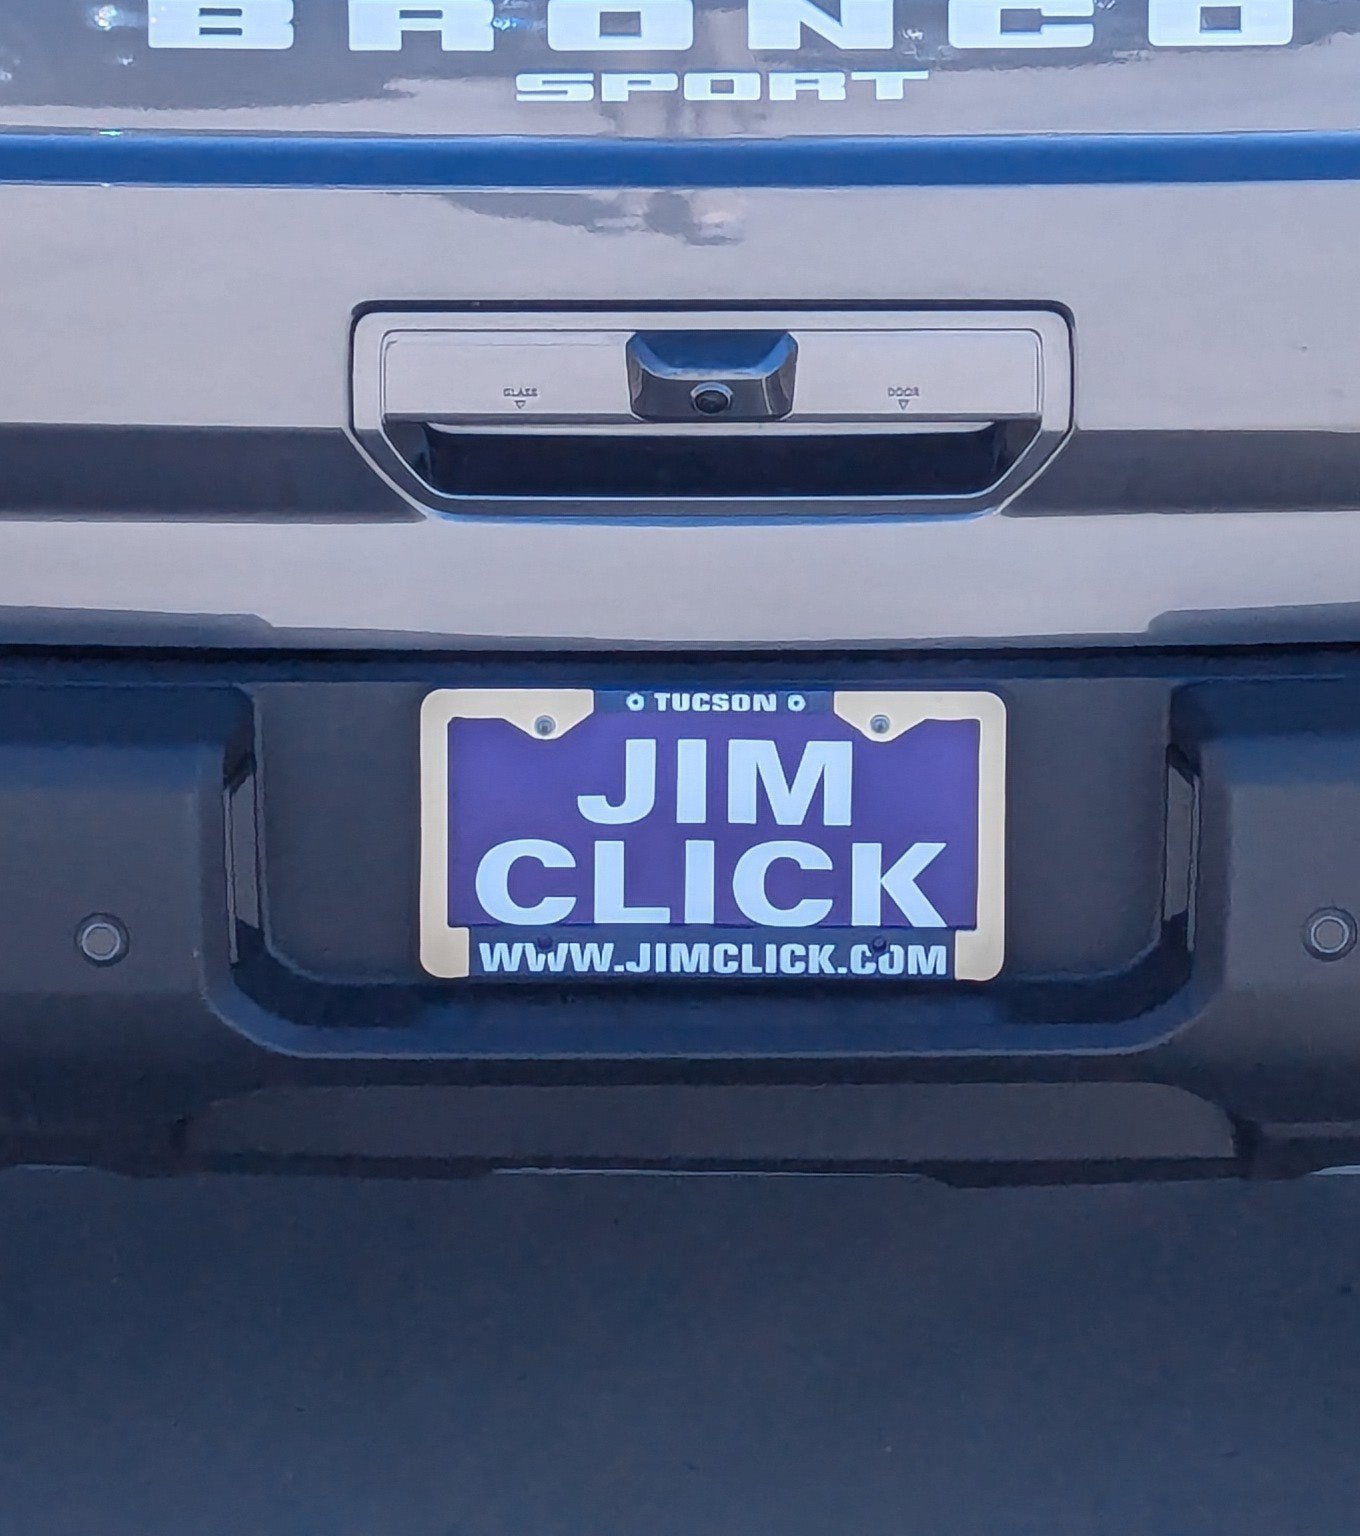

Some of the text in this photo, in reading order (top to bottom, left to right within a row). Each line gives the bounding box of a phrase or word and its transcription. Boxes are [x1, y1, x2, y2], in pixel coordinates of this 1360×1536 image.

[514, 70, 930, 103] SPORT
[503, 387, 539, 397] GLASS
[887, 386, 919, 397] DOOR
[654, 692, 778, 713] TUCSON
[577, 738, 854, 827] JIM
[475, 838, 948, 929] CLICK
[478, 941, 948, 976] WWW.JIMCLICK.COM
